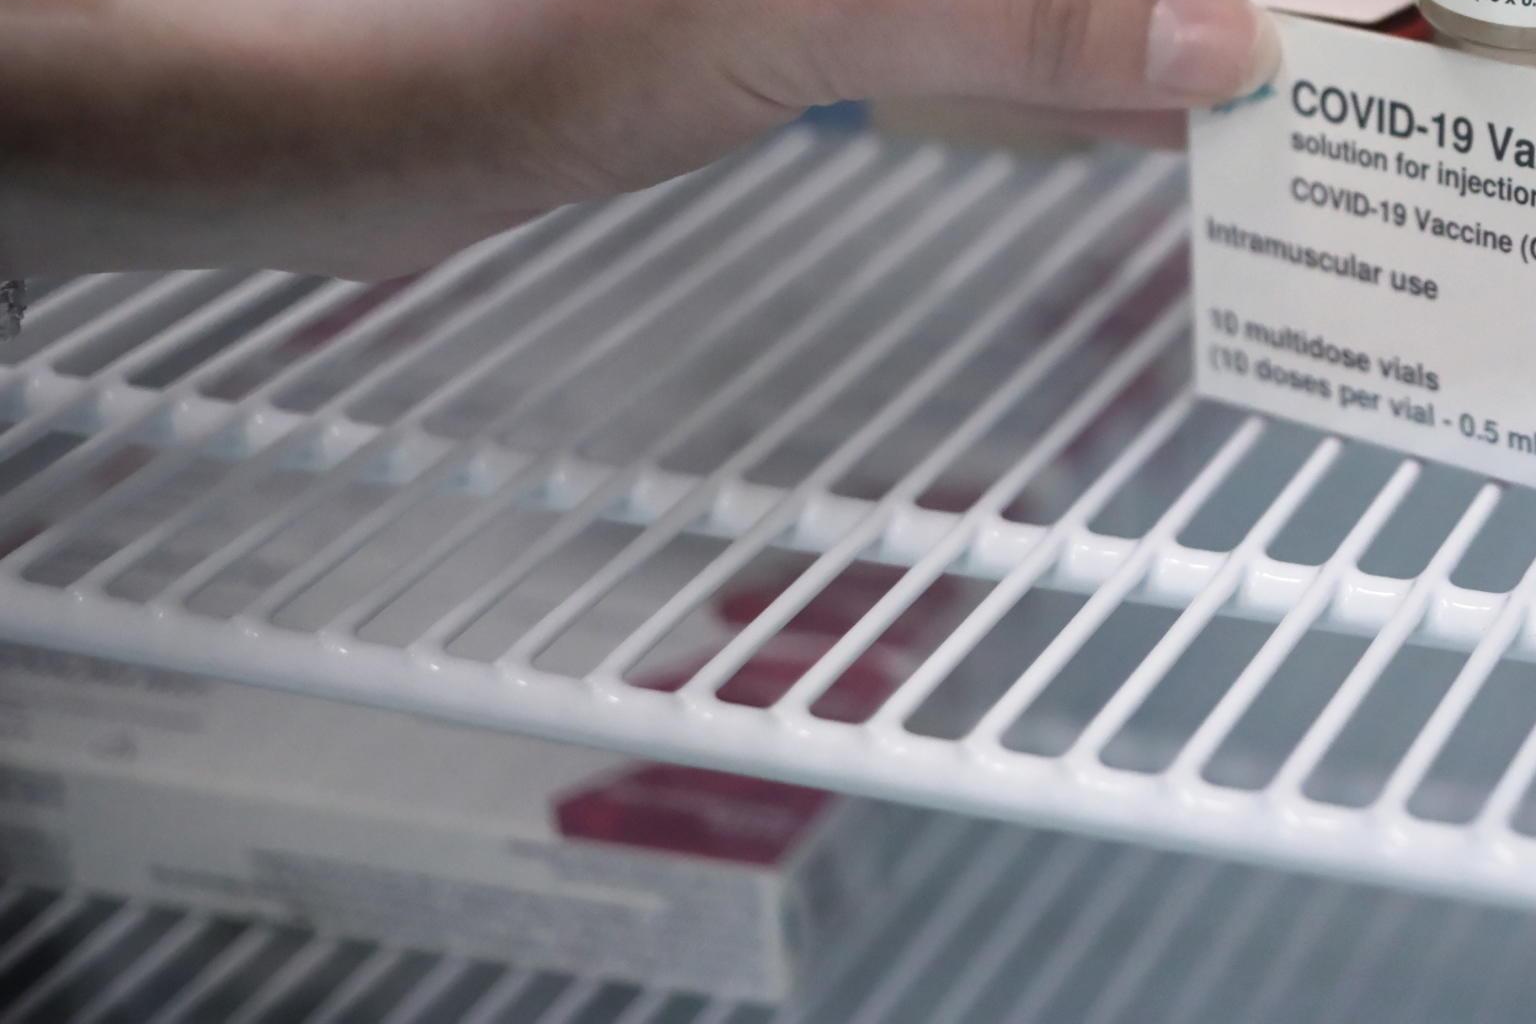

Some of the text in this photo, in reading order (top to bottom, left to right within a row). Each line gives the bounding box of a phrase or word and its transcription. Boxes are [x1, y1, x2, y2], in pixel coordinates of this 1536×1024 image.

[1291, 79, 1474, 153] COVID-19
[1291, 130, 1387, 172] solution
[1395, 152, 1429, 181] for
[1290, 177, 1407, 227] COVID-19
[1414, 207, 1513, 253] Vaccine
[1206, 217, 1438, 300] Intramuscular use
[1209, 309, 1440, 392] 10 multidose vials
[1209, 343, 1249, 375] (10
[1256, 357, 1331, 398] doses
[1339, 383, 1379, 411] per
[1388, 394, 1435, 428] vial
[1459, 413, 1499, 445] 0.5
